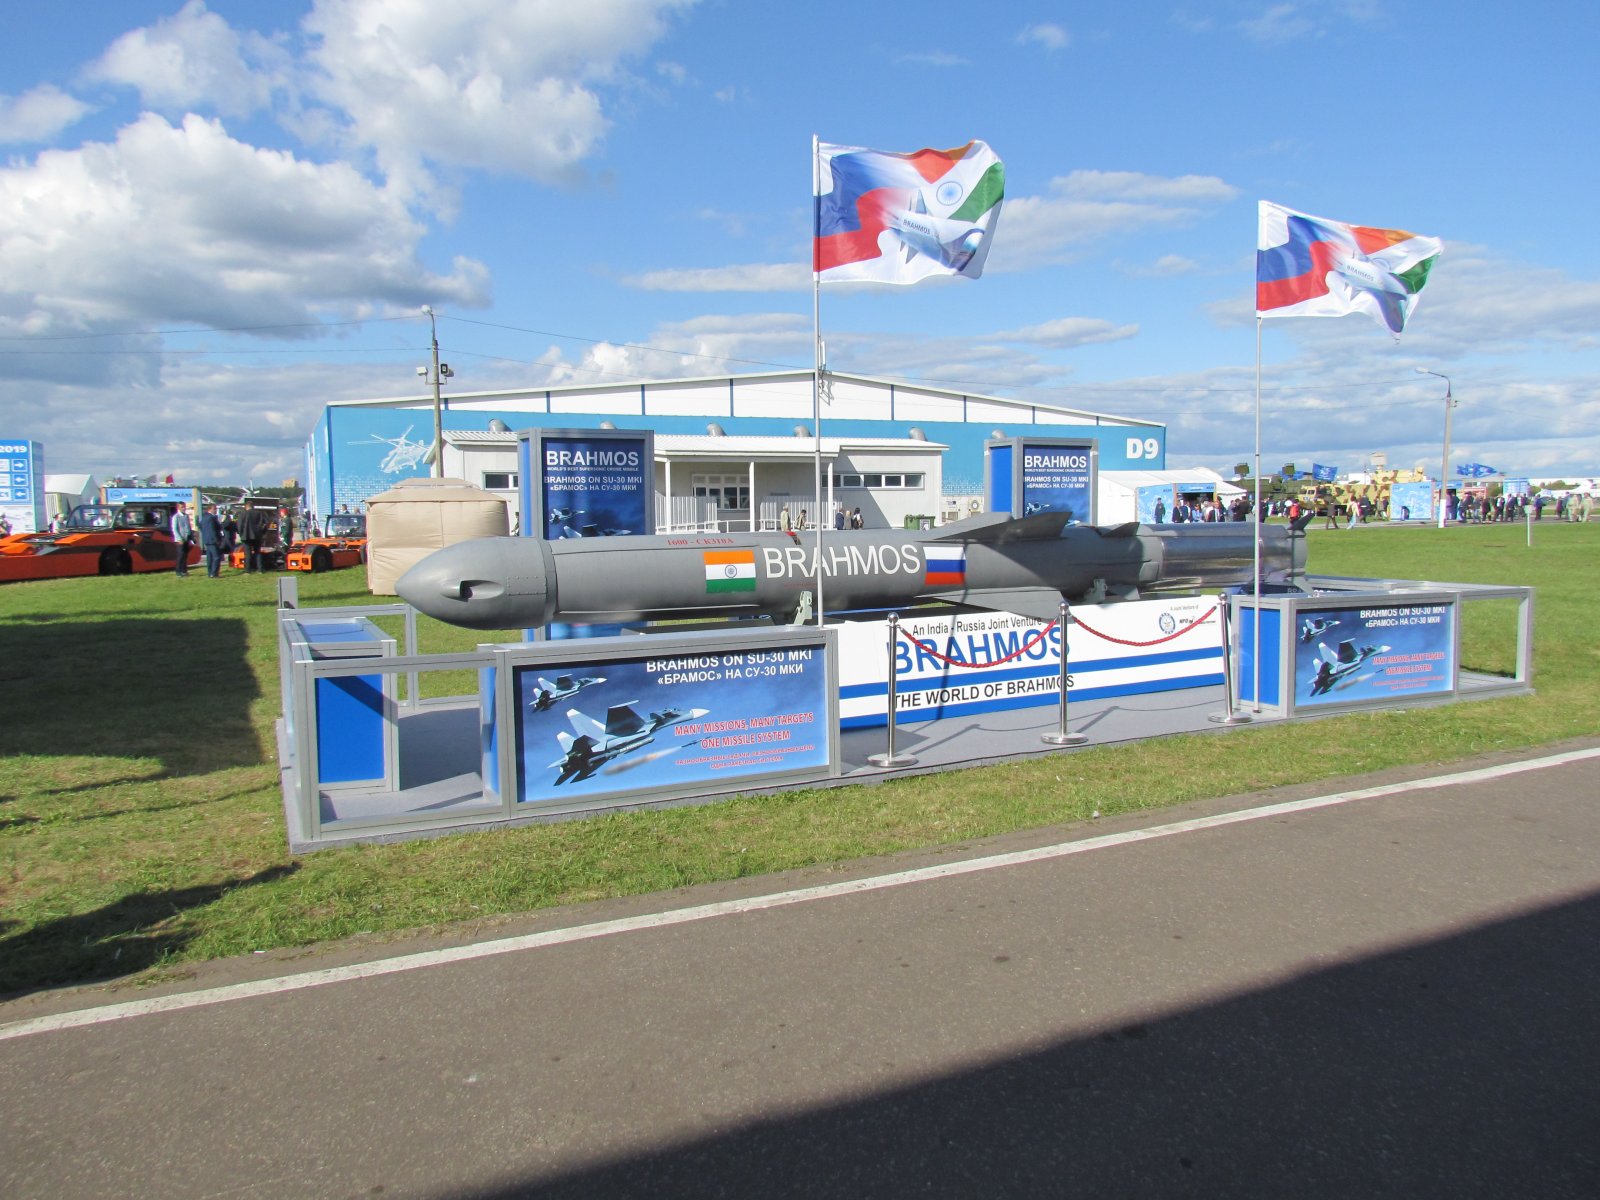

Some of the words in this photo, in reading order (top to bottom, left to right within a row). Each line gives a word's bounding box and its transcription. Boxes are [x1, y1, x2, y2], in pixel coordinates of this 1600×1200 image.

[902, 219, 931, 235] BRAHMOS
[0, 445, 27, 453] 2019
[546, 450, 639, 466] BRAHMOS
[1126, 438, 1159, 460] D9
[1024, 455, 1087, 468] BRAHMOS
[544, 475, 586, 484] BRAHMOS
[588, 476, 600, 484] ON
[602, 476, 626, 484] SU-30
[627, 475, 642, 484] MKI
[762, 544, 921, 579] BRAHMOS
[1360, 608, 1398, 618] BRAHMOS
[1399, 607, 1410, 616] ON
[1432, 606, 1446, 614] MKI
[912, 624, 925, 636] An
[927, 621, 949, 635] India
[956, 619, 986, 633] Russia
[988, 617, 1009, 630] Joint
[1010, 616, 1042, 628] Venture
[646, 655, 719, 672] BRAHMOS
[723, 653, 743, 666] ON
[747, 650, 785, 665] SU-30
[788, 648, 812, 661] MKI
[886, 626, 1070, 675] BRAHMOS
[657, 670, 722, 685] «БРАМОС»
[725, 668, 742, 679] НА
[745, 665, 776, 678] СУ-30
[779, 663, 803, 675] МКИ
[895, 692, 921, 709] THE
[925, 686, 980, 705] WORLD
[984, 683, 1003, 698] OF
[674, 724, 701, 736] MANY
[703, 719, 748, 734] MISSIONS,
[750, 717, 775, 729] MANY
[777, 712, 814, 725] TARGETS
[701, 738, 720, 750] ONE
[722, 734, 755, 747] MISSILE
[757, 730, 791, 743] SYSTEM
